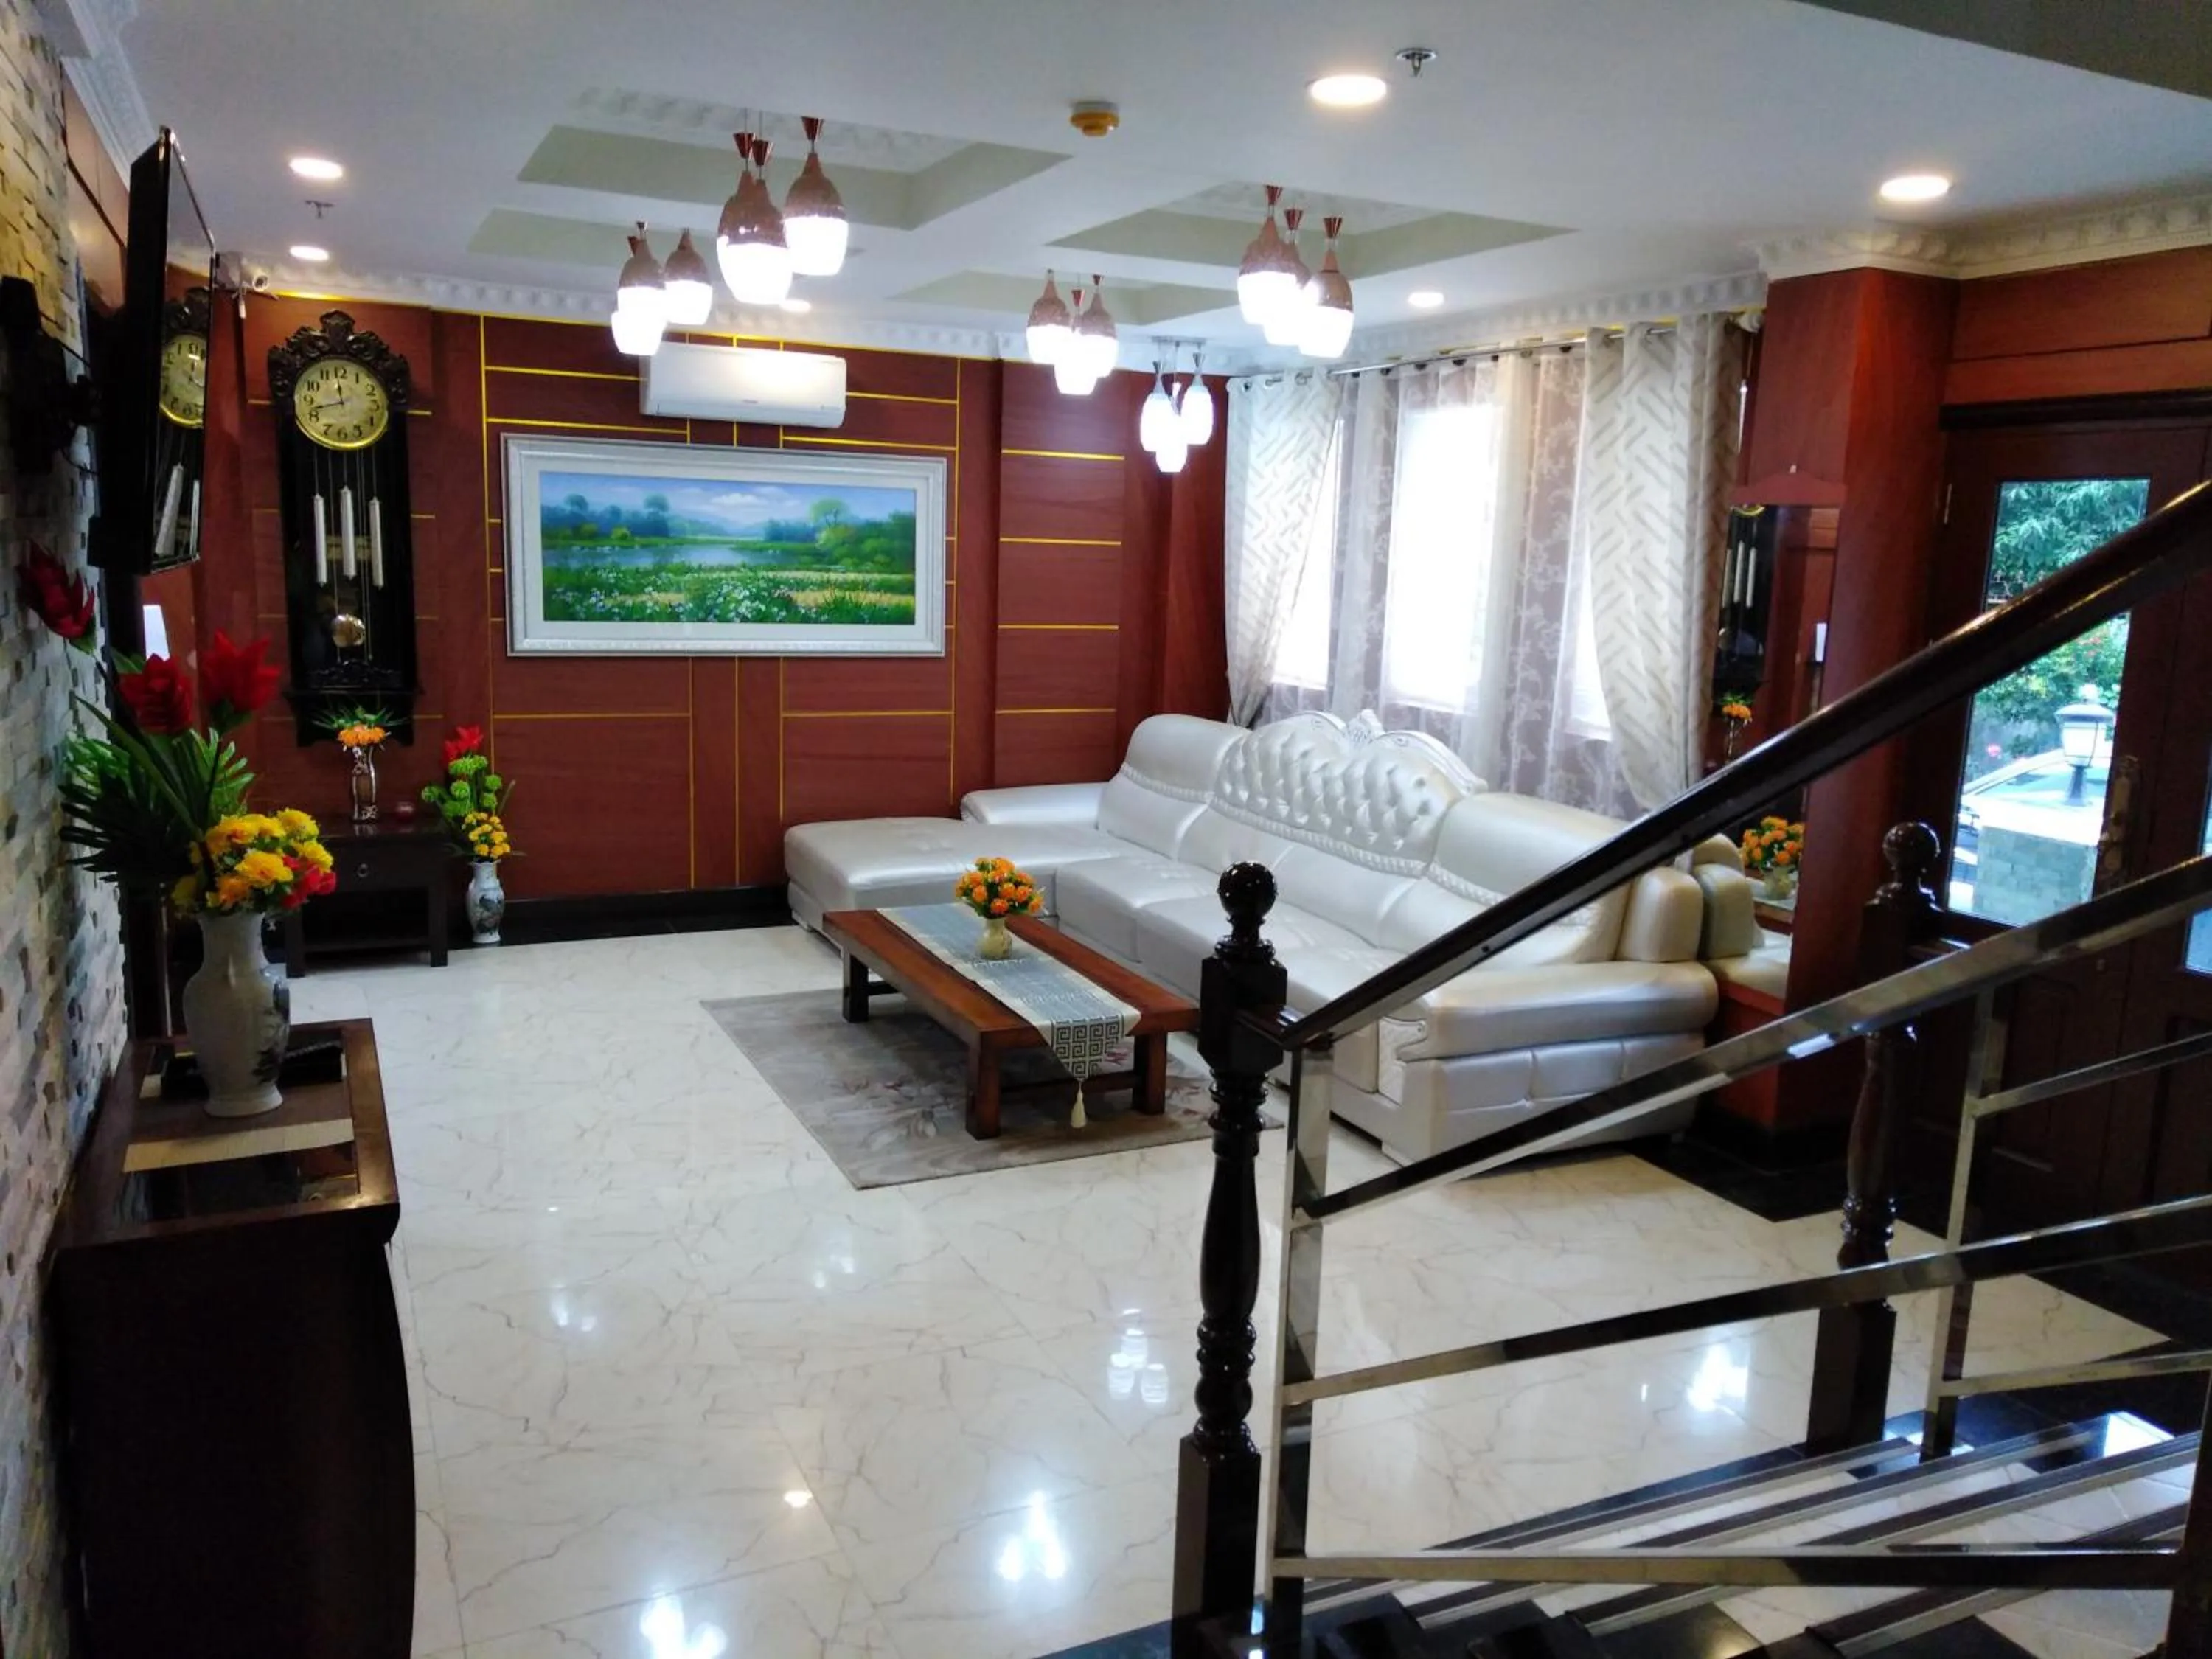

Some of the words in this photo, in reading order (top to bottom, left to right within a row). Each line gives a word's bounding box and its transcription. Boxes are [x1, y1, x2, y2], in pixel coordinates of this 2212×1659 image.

[320, 369, 329, 380] 11
[335, 366, 347, 378] 12
[355, 372, 359, 383] 1
[307, 380, 319, 391] 10
[366, 383, 375, 396] 2
[303, 394, 313, 406] 9
[308, 409, 319, 422] 8
[323, 424, 333, 436] 7
[337, 426, 348, 440] 6
